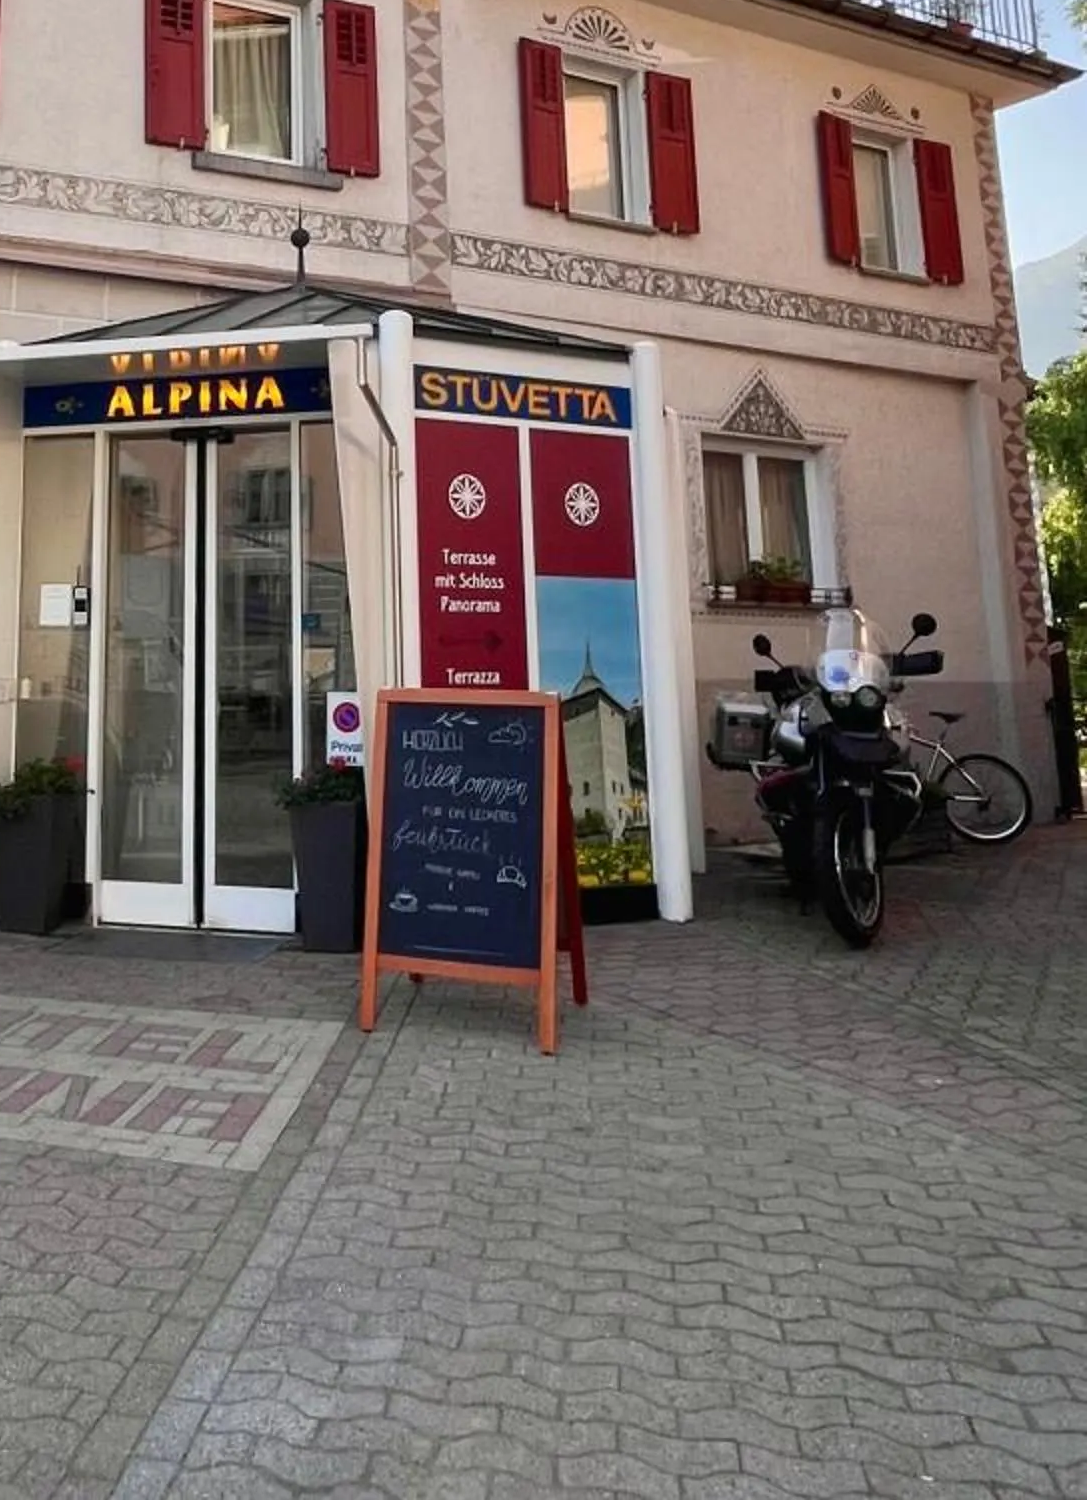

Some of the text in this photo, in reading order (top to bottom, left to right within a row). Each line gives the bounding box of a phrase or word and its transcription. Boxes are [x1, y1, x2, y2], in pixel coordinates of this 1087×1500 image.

[106, 375, 285, 417] ALPINA
[420, 371, 618, 422] STÜVETTA
[442, 549, 496, 566] Terrasse
[434, 572, 505, 589] mit Schloss
[440, 596, 502, 613] Panorama
[445, 668, 501, 685] Terrazza
